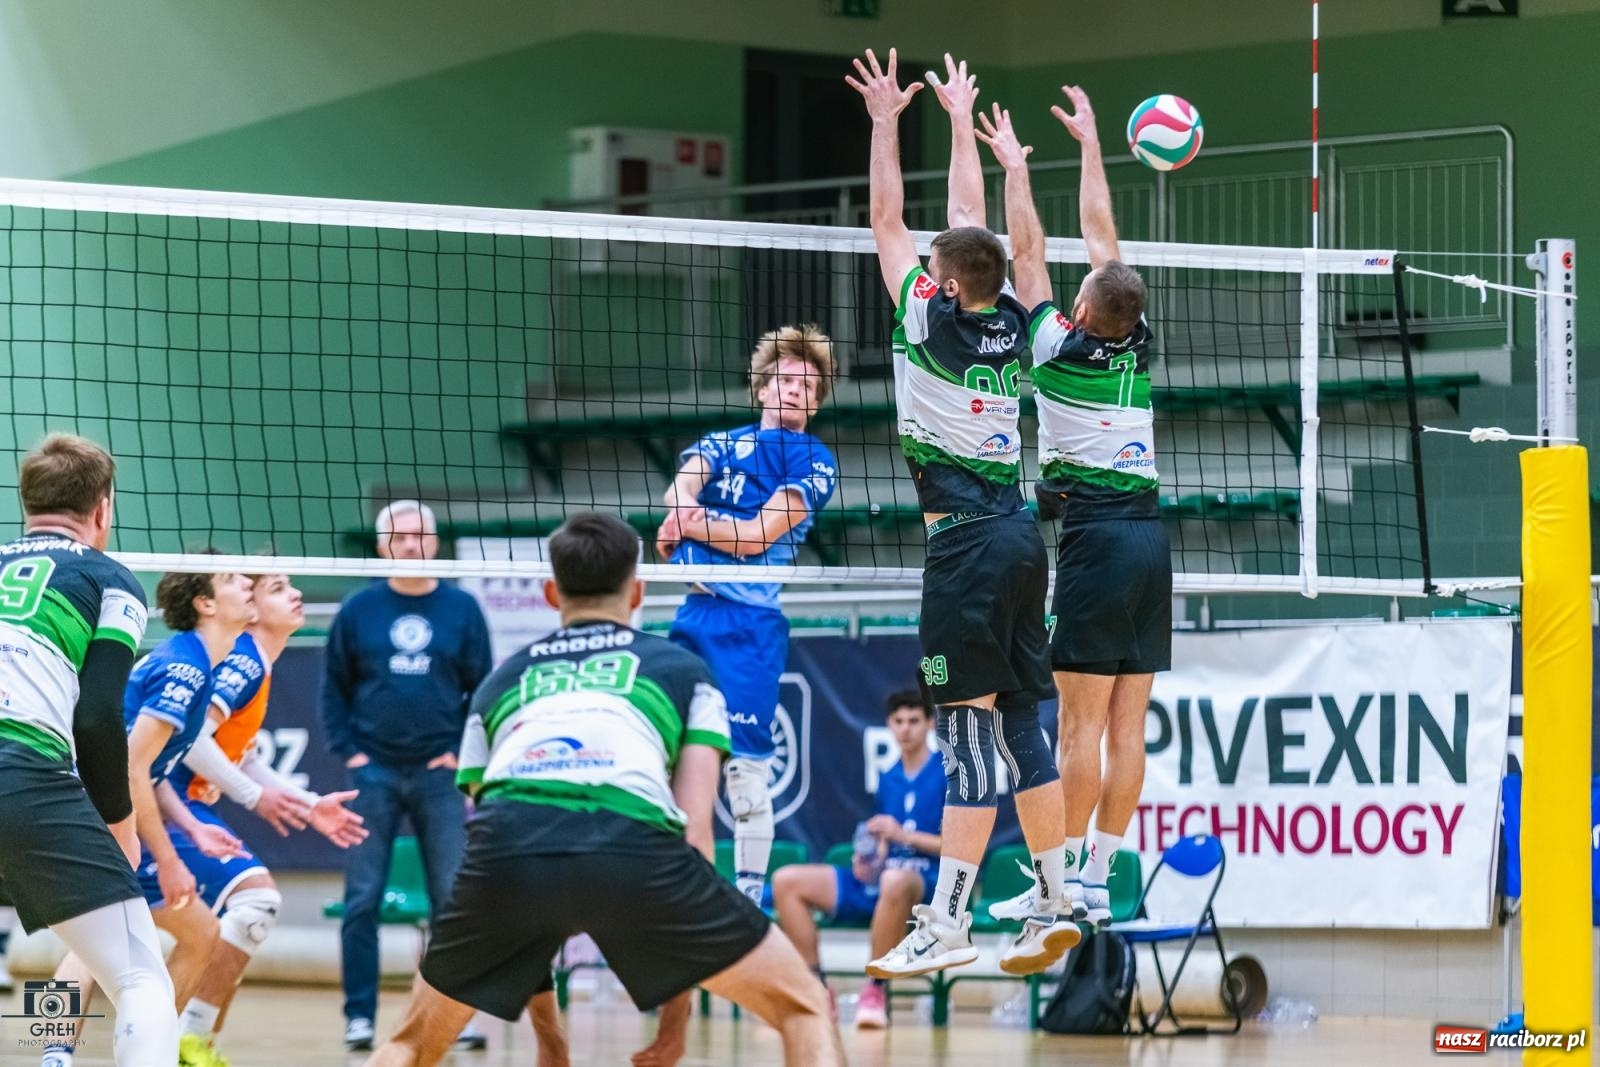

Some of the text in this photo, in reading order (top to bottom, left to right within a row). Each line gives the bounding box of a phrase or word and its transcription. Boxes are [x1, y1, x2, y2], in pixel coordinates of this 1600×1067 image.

[1364, 257, 1389, 266] netex
[1109, 350, 1137, 408] 7
[920, 655, 949, 686] 99
[1145, 692, 1469, 785] PIVEXIN
[1137, 803, 1465, 856] TECHNOLOGY
[948, 868, 967, 920] SKECHERS
